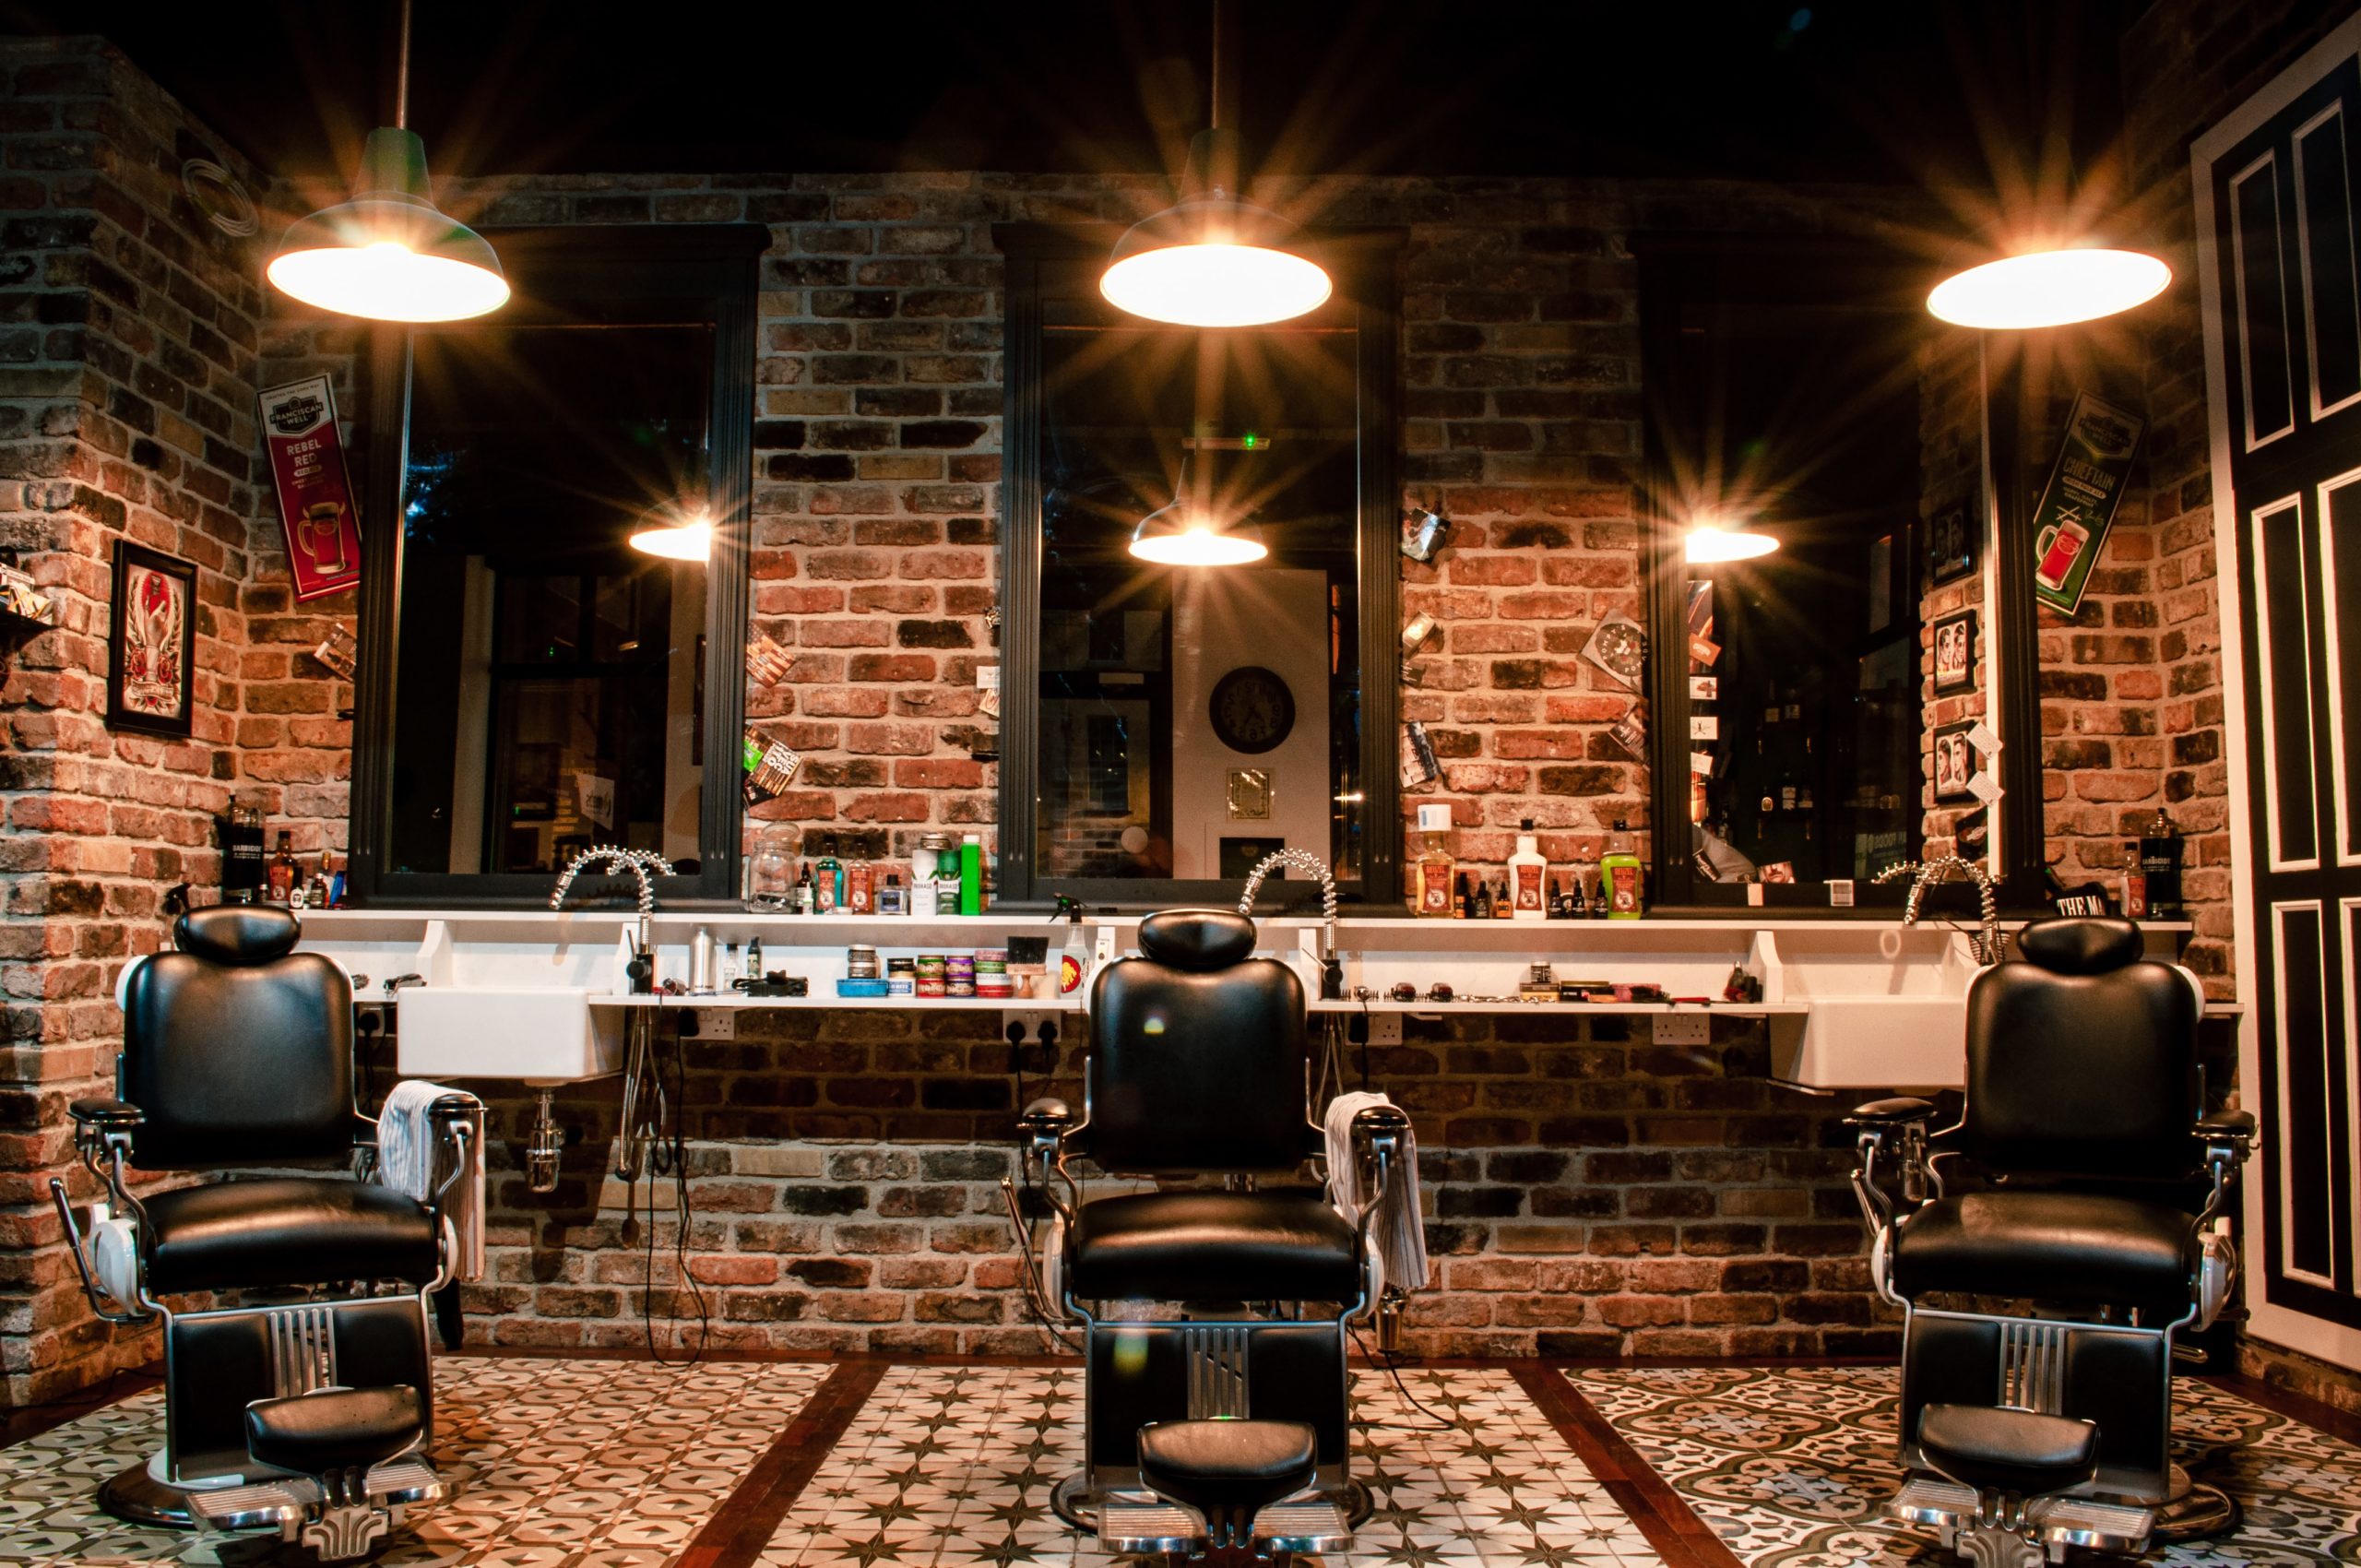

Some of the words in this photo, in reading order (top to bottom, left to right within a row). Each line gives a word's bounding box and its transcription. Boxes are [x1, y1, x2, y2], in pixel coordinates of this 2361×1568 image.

[270, 403, 324, 423] FRANCISCAN
[287, 415, 309, 426] WELL
[286, 438, 322, 456] REBEL
[294, 452, 318, 467] RED
[2062, 456, 2117, 492] CHIEFTAIN
[774, 751, 792, 772] VEC
[781, 754, 800, 776] SUA
[2057, 896, 2086, 917] THE
